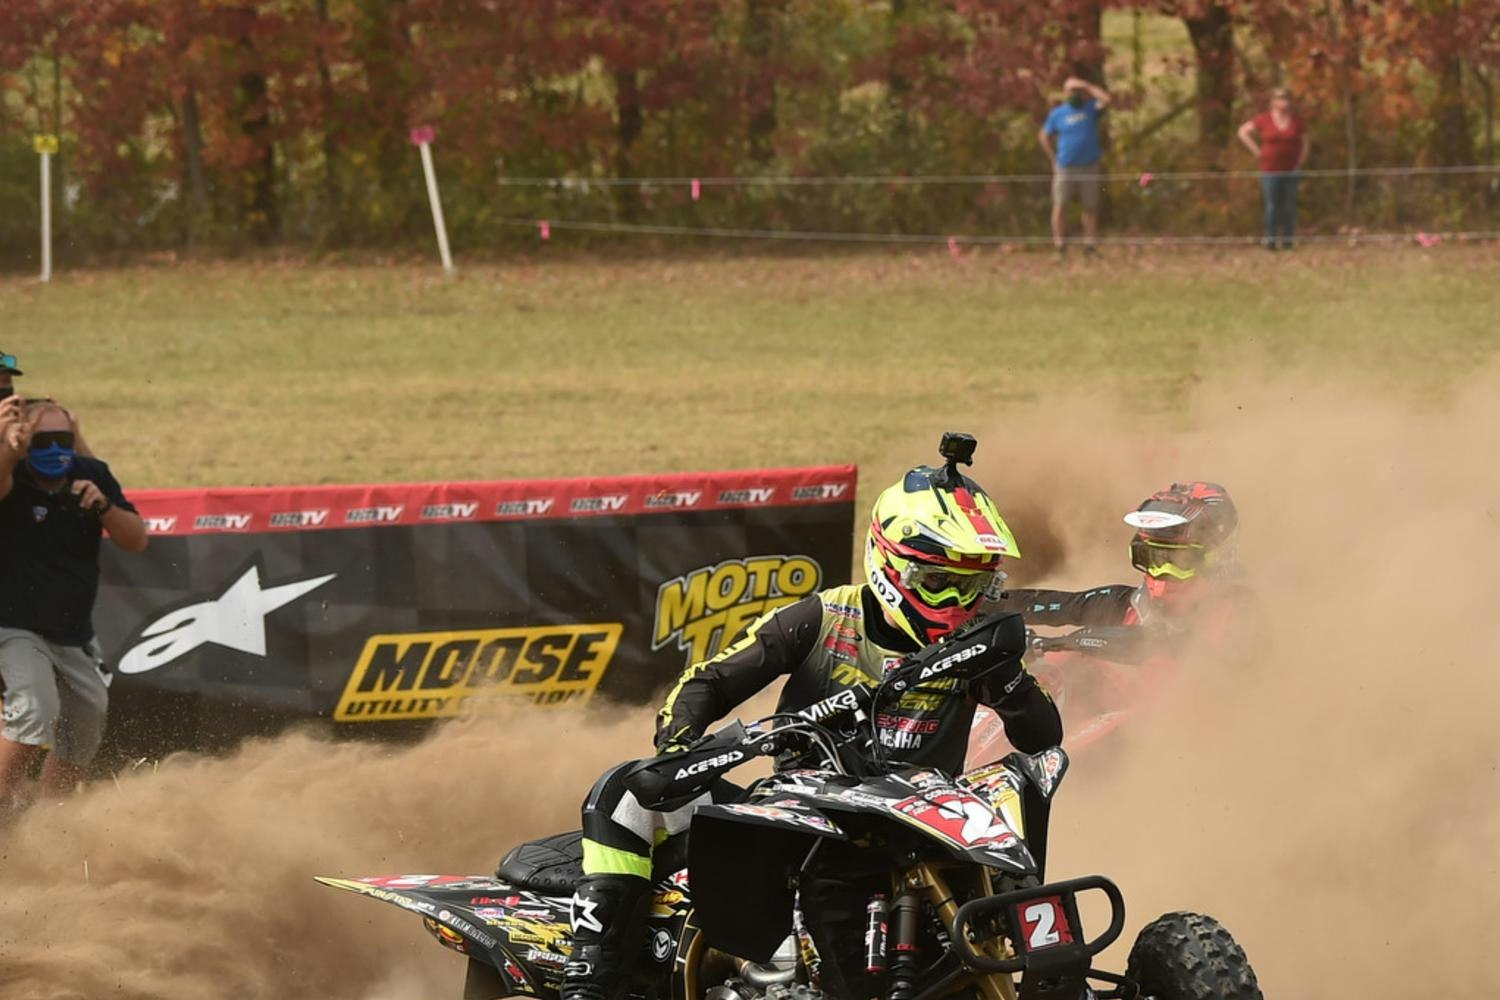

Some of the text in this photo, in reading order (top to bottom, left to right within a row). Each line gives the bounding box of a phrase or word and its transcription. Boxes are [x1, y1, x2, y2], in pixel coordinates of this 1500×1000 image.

[654, 556, 820, 646] MOTO
[870, 570, 897, 608] 002
[356, 630, 611, 692] MOOSE
[918, 643, 988, 681] ACERBIS
[674, 750, 744, 781] ACERBIS
[1024, 901, 1061, 948] 2
